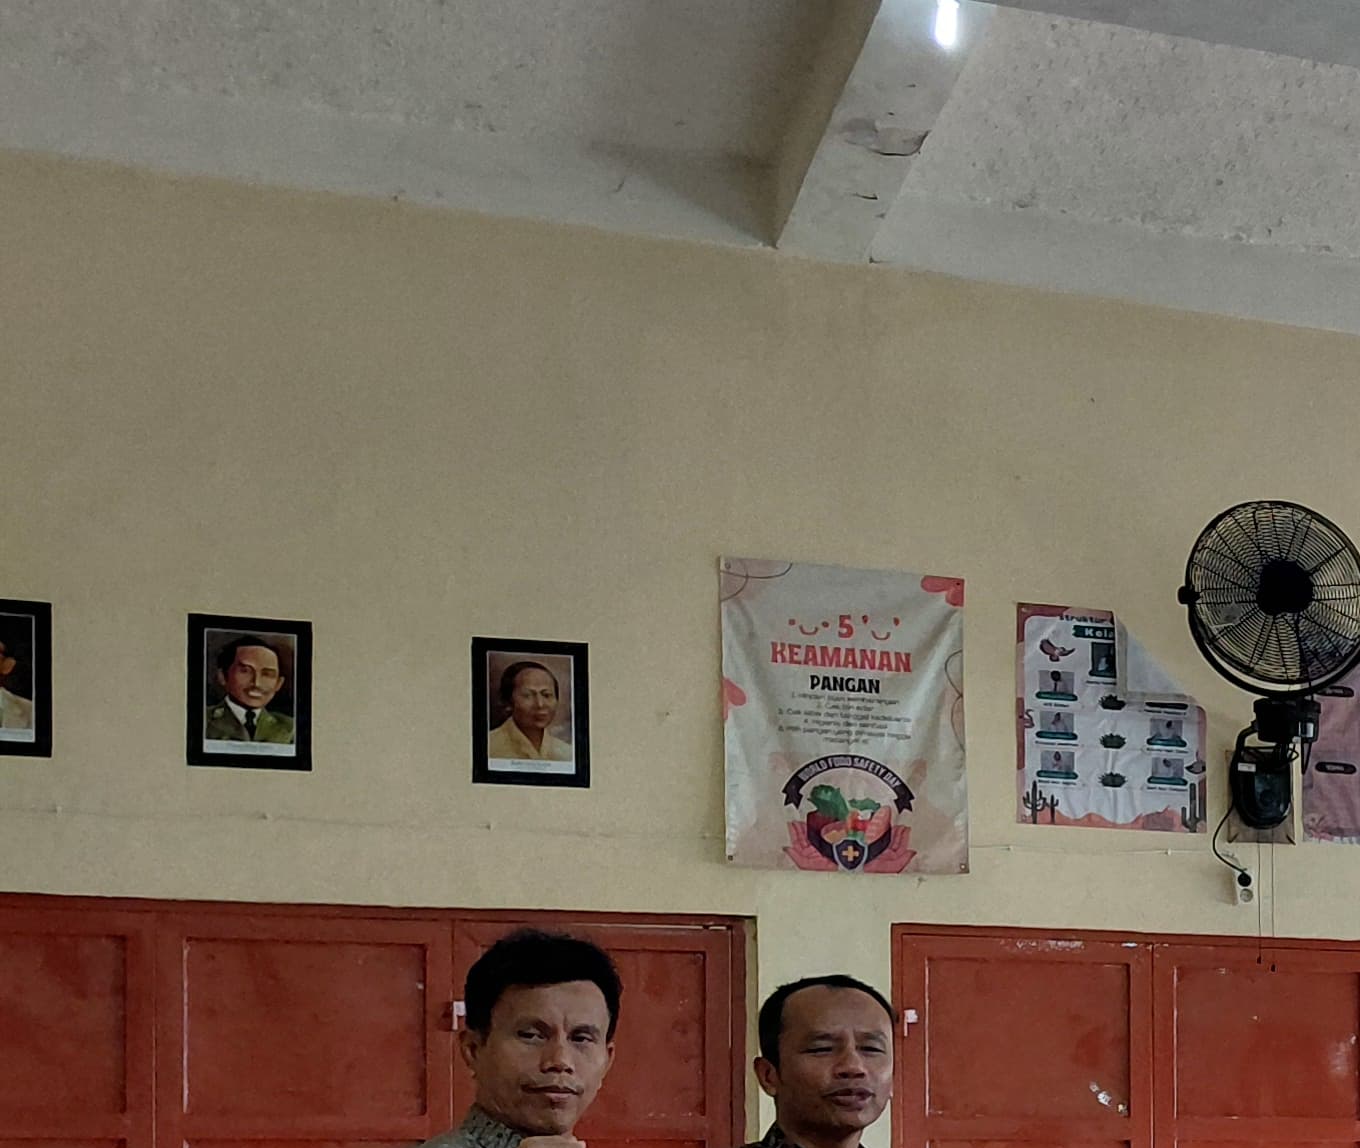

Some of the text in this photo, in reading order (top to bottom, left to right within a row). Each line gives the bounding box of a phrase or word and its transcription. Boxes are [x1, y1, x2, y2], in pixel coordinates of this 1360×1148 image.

[838, 614, 854, 639] 5
[770, 641, 912, 673] KEAMANAN
[810, 674, 880, 693] PANGAN
[853, 757, 887, 776] SAFETY
[882, 771, 902, 788] DAY
